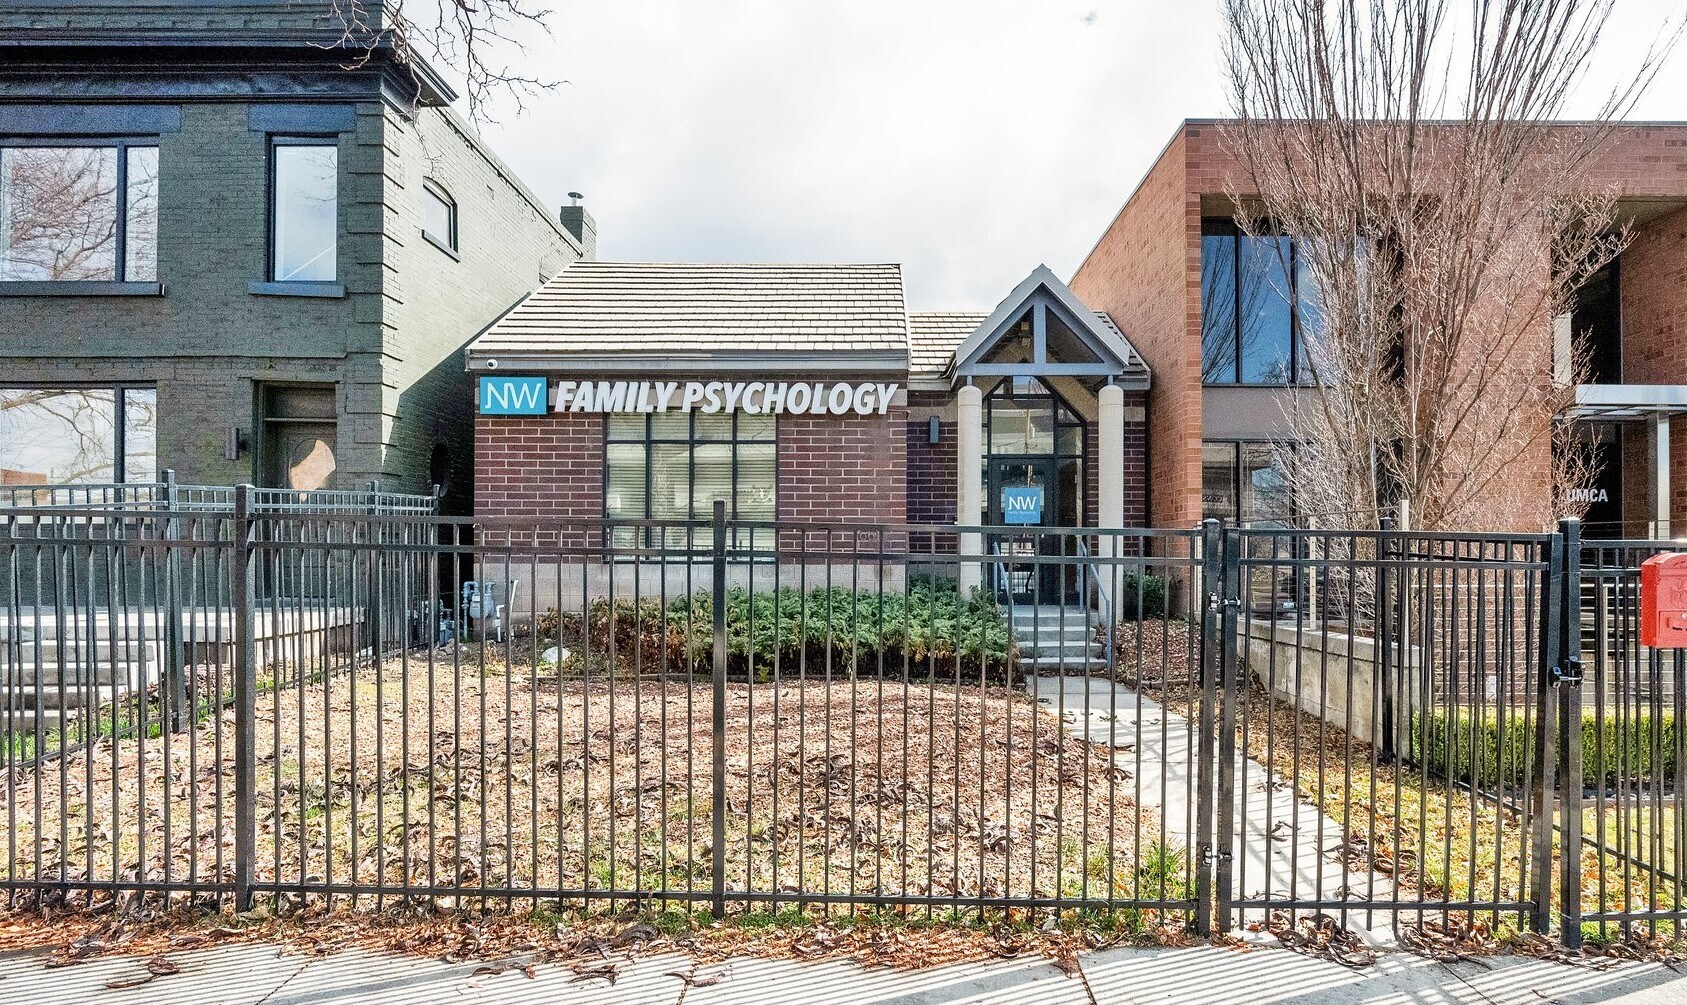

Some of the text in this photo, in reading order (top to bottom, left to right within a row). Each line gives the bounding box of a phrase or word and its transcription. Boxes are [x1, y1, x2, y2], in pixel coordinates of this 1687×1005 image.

[484, 381, 899, 415] NW FAMILY PSYCHOLOGY
[1008, 496, 1037, 510] NW
